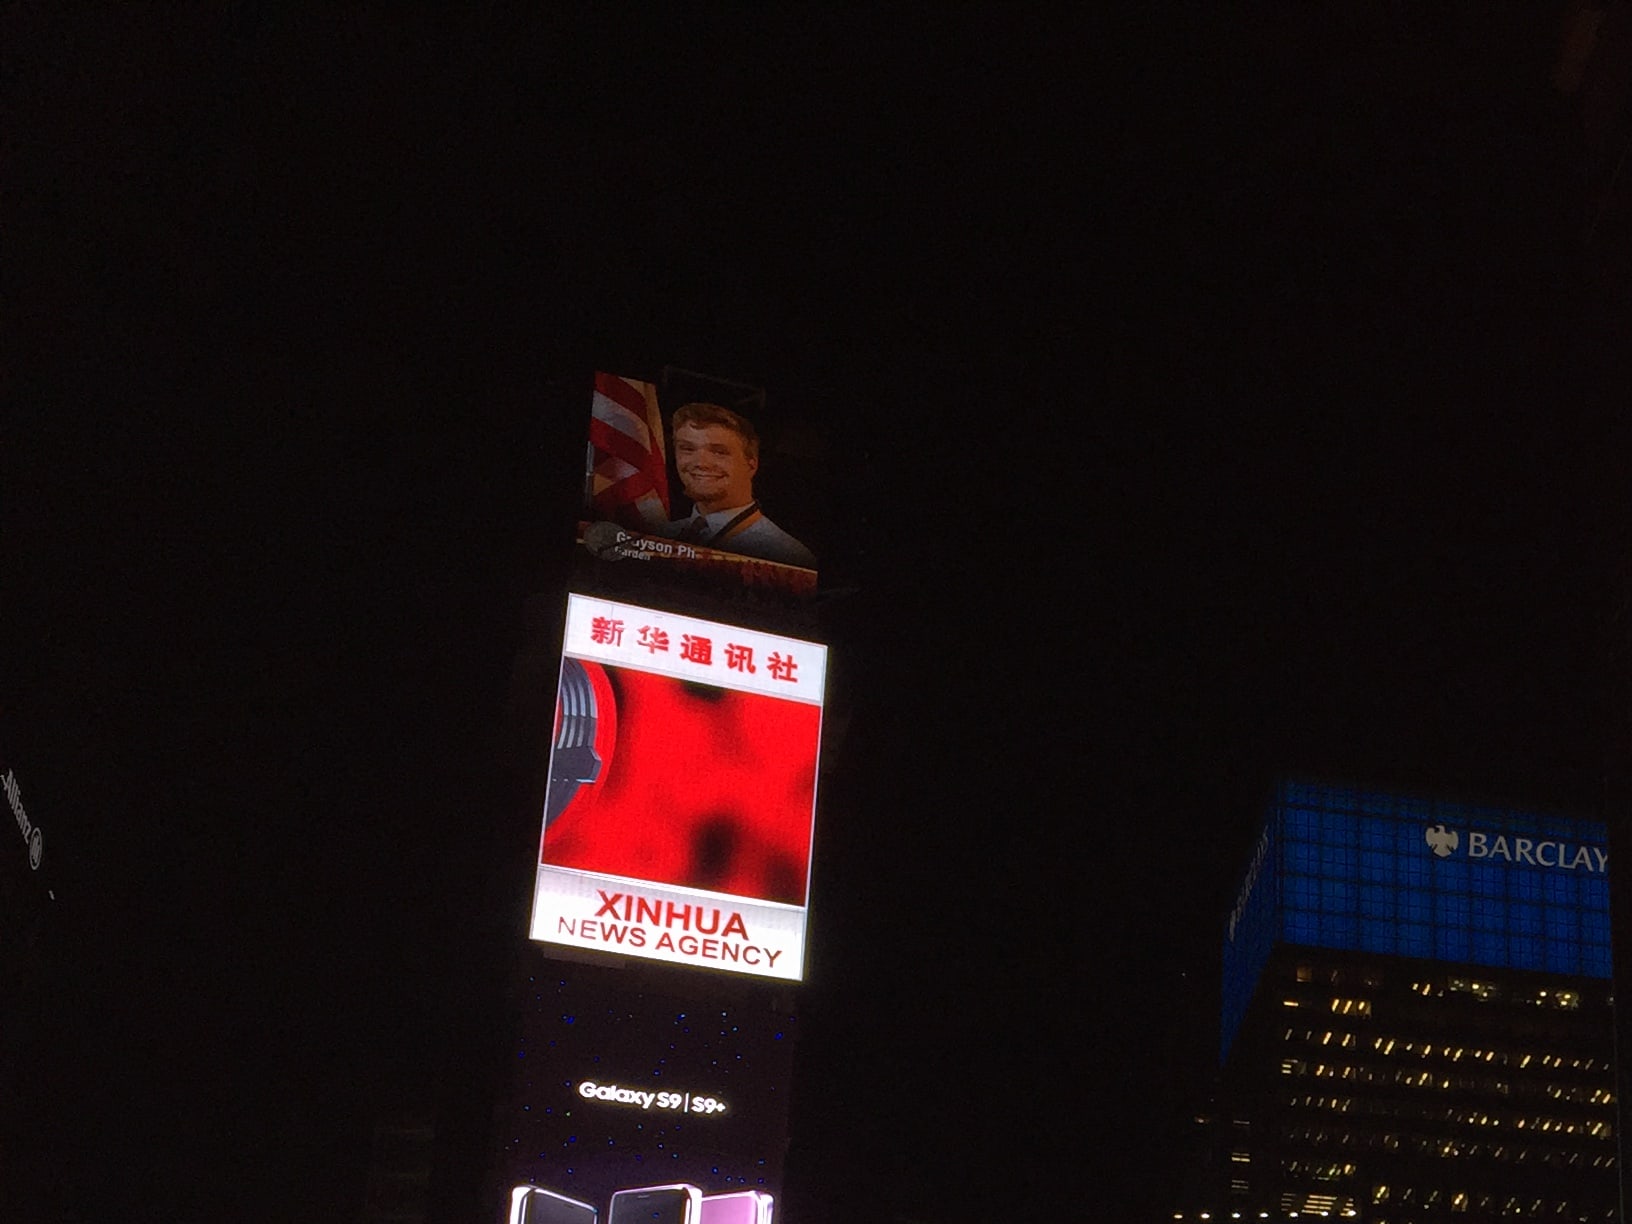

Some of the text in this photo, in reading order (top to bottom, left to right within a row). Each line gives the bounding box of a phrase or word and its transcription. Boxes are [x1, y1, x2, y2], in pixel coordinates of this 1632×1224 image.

[590, 616, 799, 684] 新华通讯社
[1468, 831, 1608, 872] BARCLAY
[595, 890, 749, 941] XINHUA
[557, 917, 783, 970] NEWS AGENCY
[579, 1081, 727, 1113] Galaxy S9 S9+
